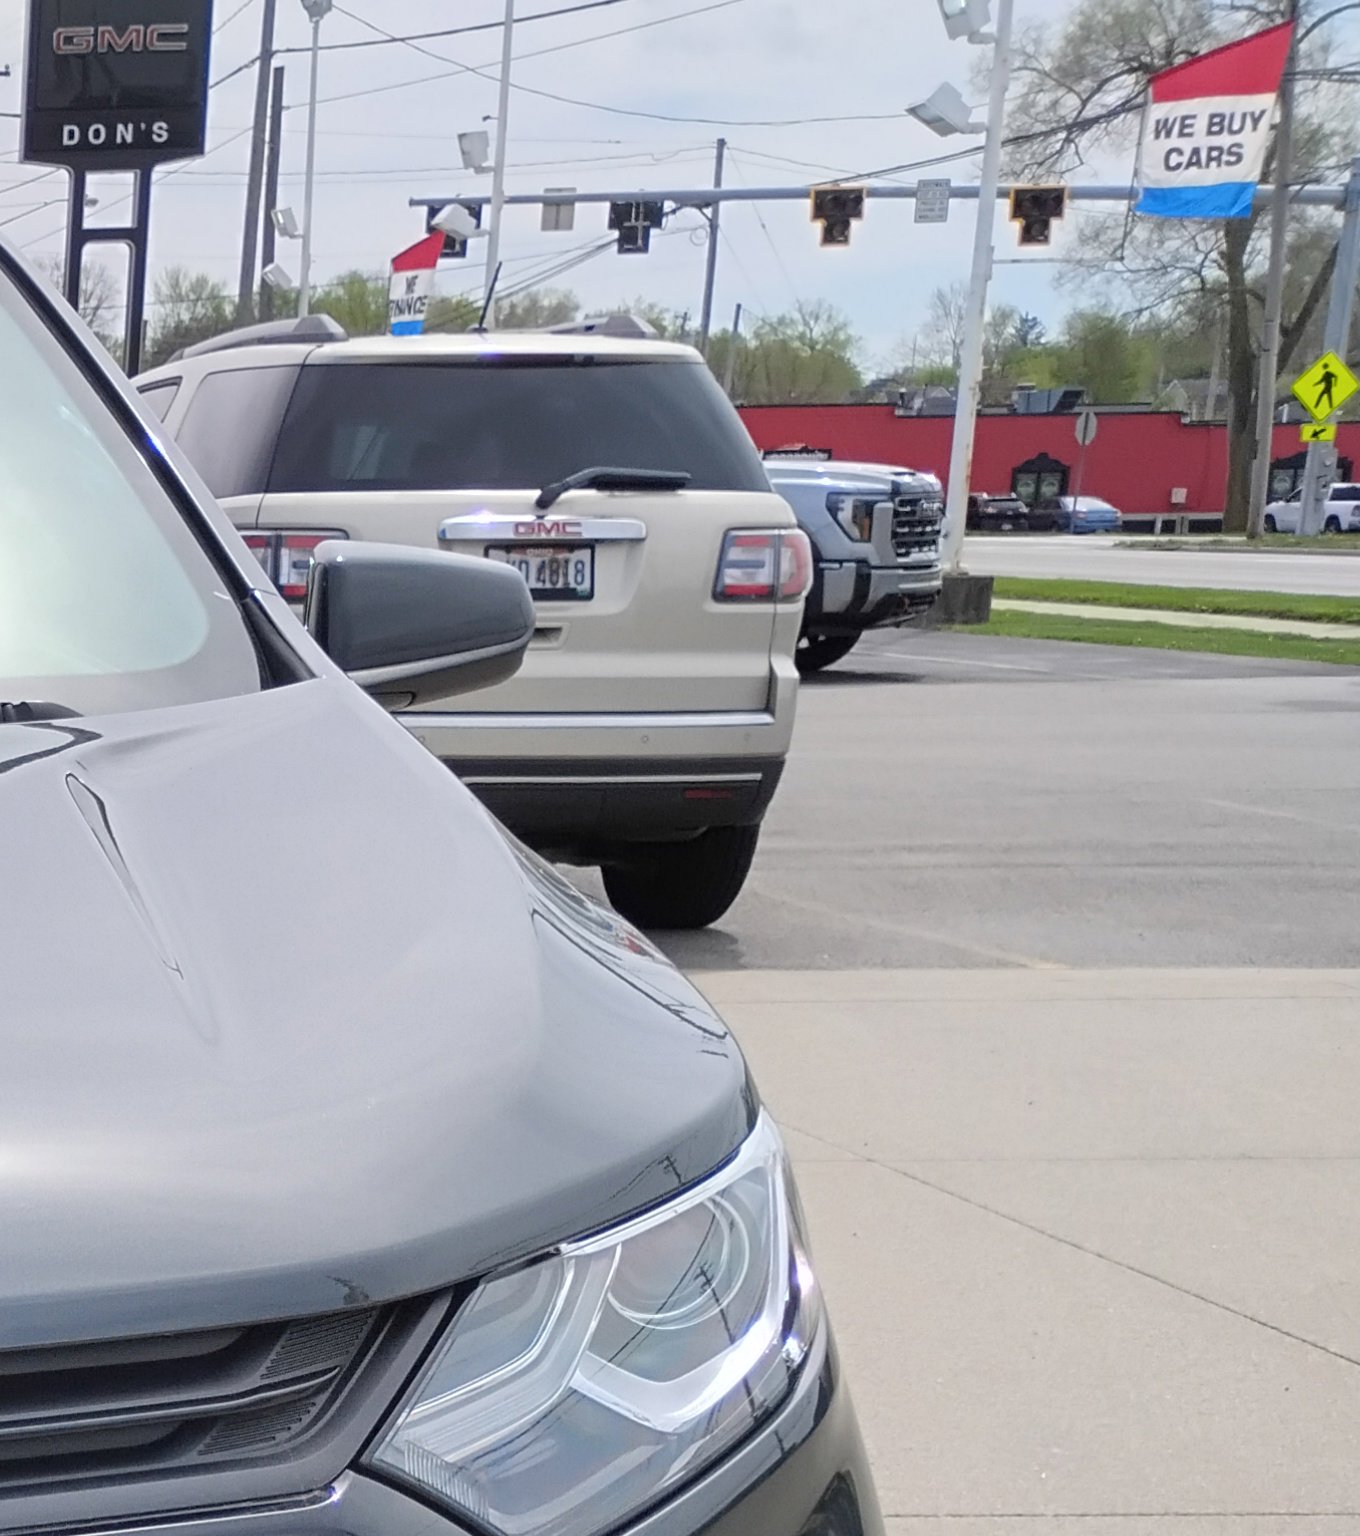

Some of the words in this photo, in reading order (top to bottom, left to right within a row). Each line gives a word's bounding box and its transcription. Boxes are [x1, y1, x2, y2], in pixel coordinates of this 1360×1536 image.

[53, 24, 189, 54] GMC
[62, 121, 169, 146] DON'S
[1154, 114, 1198, 140] WE
[1206, 109, 1268, 136] BUY
[1163, 143, 1244, 172] CARS
[513, 521, 583, 537] GMC
